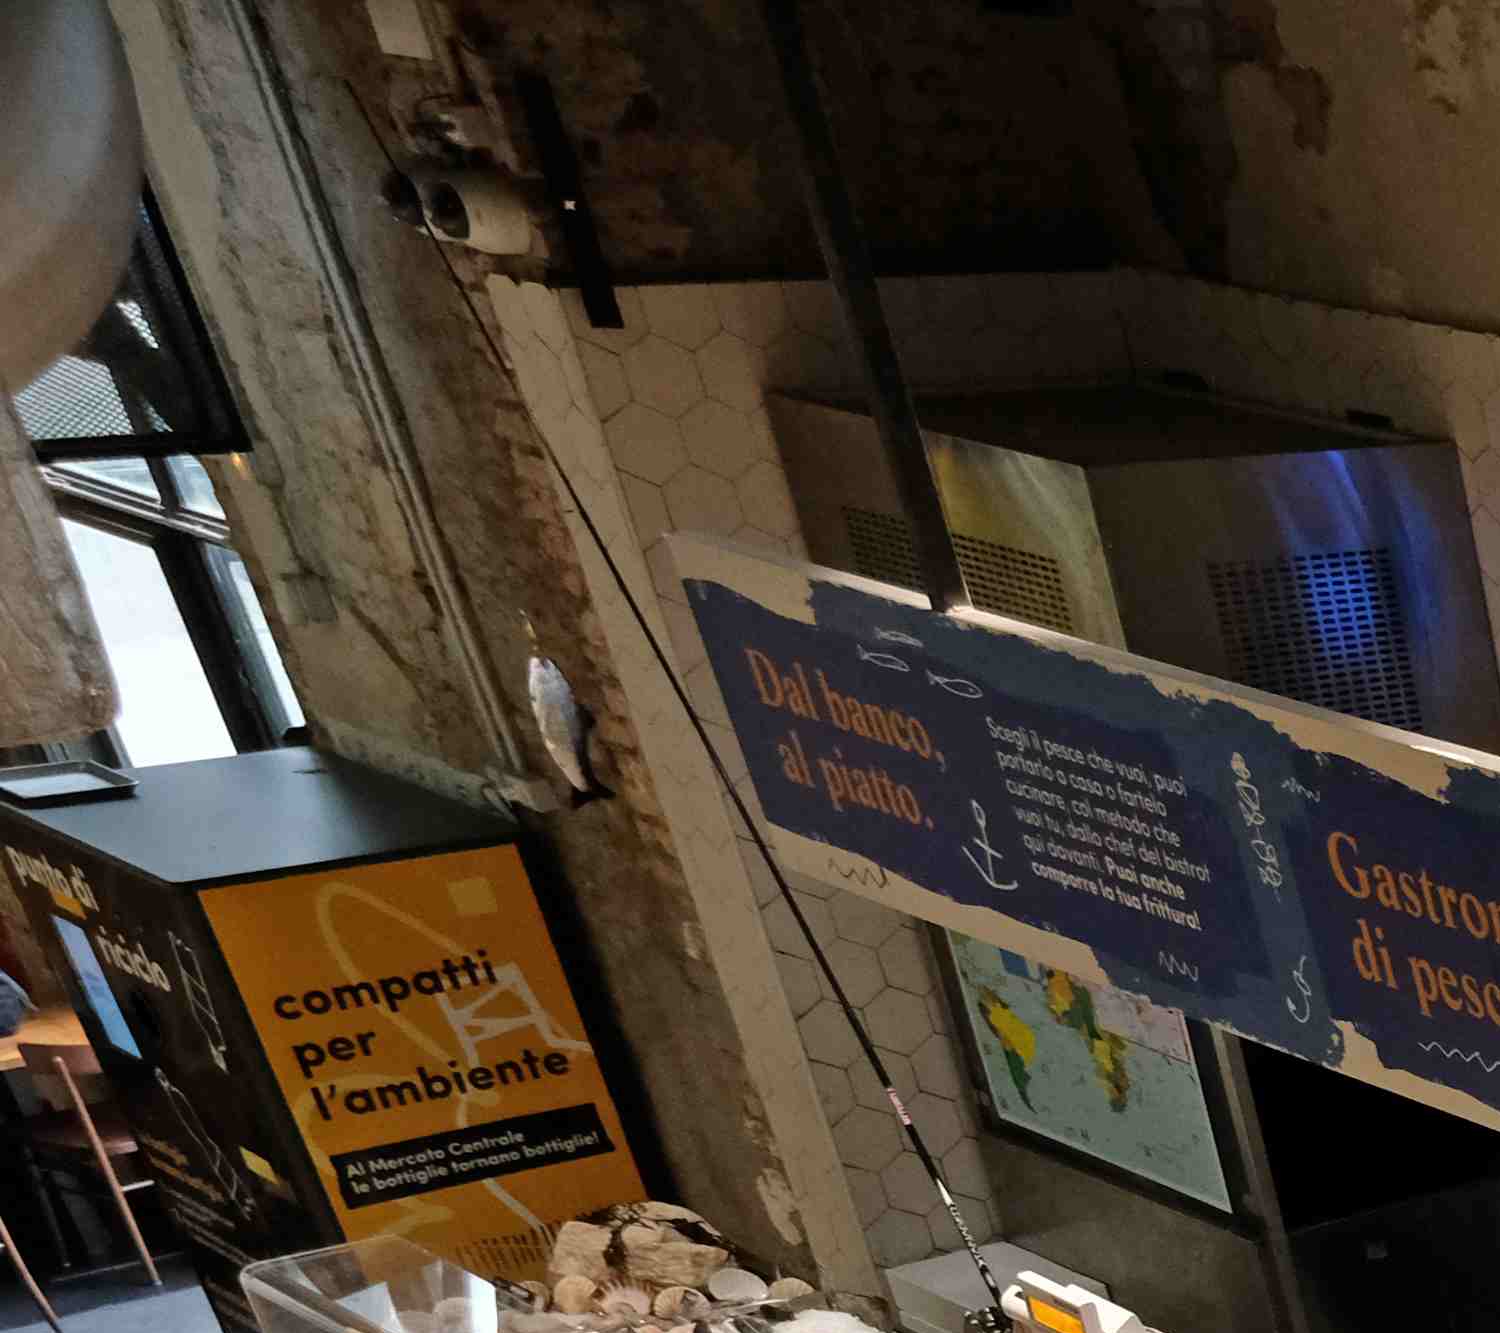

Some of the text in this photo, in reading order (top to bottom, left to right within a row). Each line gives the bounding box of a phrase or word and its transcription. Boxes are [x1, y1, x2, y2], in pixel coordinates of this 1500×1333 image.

[744, 647, 946, 774] Dal banco,
[776, 729, 935, 832] al piatto.
[1042, 739, 1086, 765] pesce
[1086, 747, 1115, 774] che
[1068, 773, 1104, 798] casa
[1094, 807, 1151, 838] metodo
[1152, 823, 1182, 848] che
[1103, 835, 1136, 858] chef
[1137, 845, 1161, 867] del
[1162, 851, 1211, 884] bistrot
[1103, 854, 1137, 881] Puoi
[1138, 871, 1186, 901] anche
[69, 863, 101, 912] di
[1031, 861, 1203, 933] comporre la tua frittura!
[1352, 918, 1400, 991] di
[273, 948, 498, 1020] compatti
[290, 1031, 376, 1080] per
[310, 1048, 569, 1121] l'ambiente
[345, 1130, 526, 1179] Al Mercato Centrale
[352, 1130, 601, 1196] le bottiglie tornano bottiglie!
